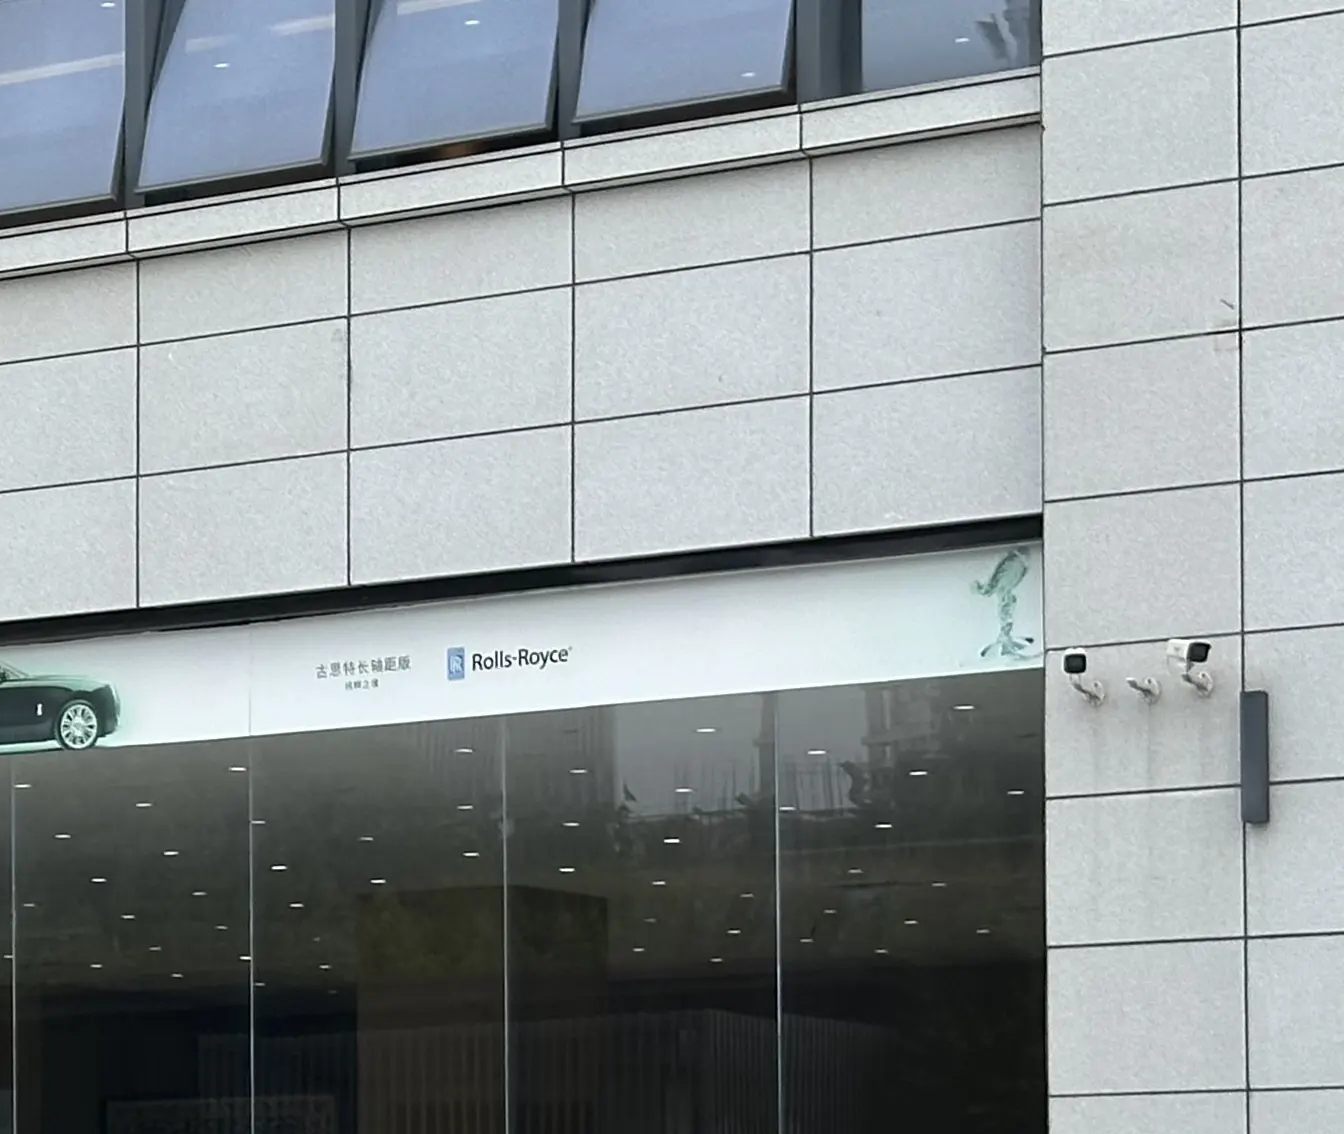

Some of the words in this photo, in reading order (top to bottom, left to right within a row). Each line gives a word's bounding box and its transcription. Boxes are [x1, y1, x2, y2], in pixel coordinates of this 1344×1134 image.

[315, 655, 411, 679] 古思特长轴距版
[472, 648, 570, 671] Rolls-Royce
